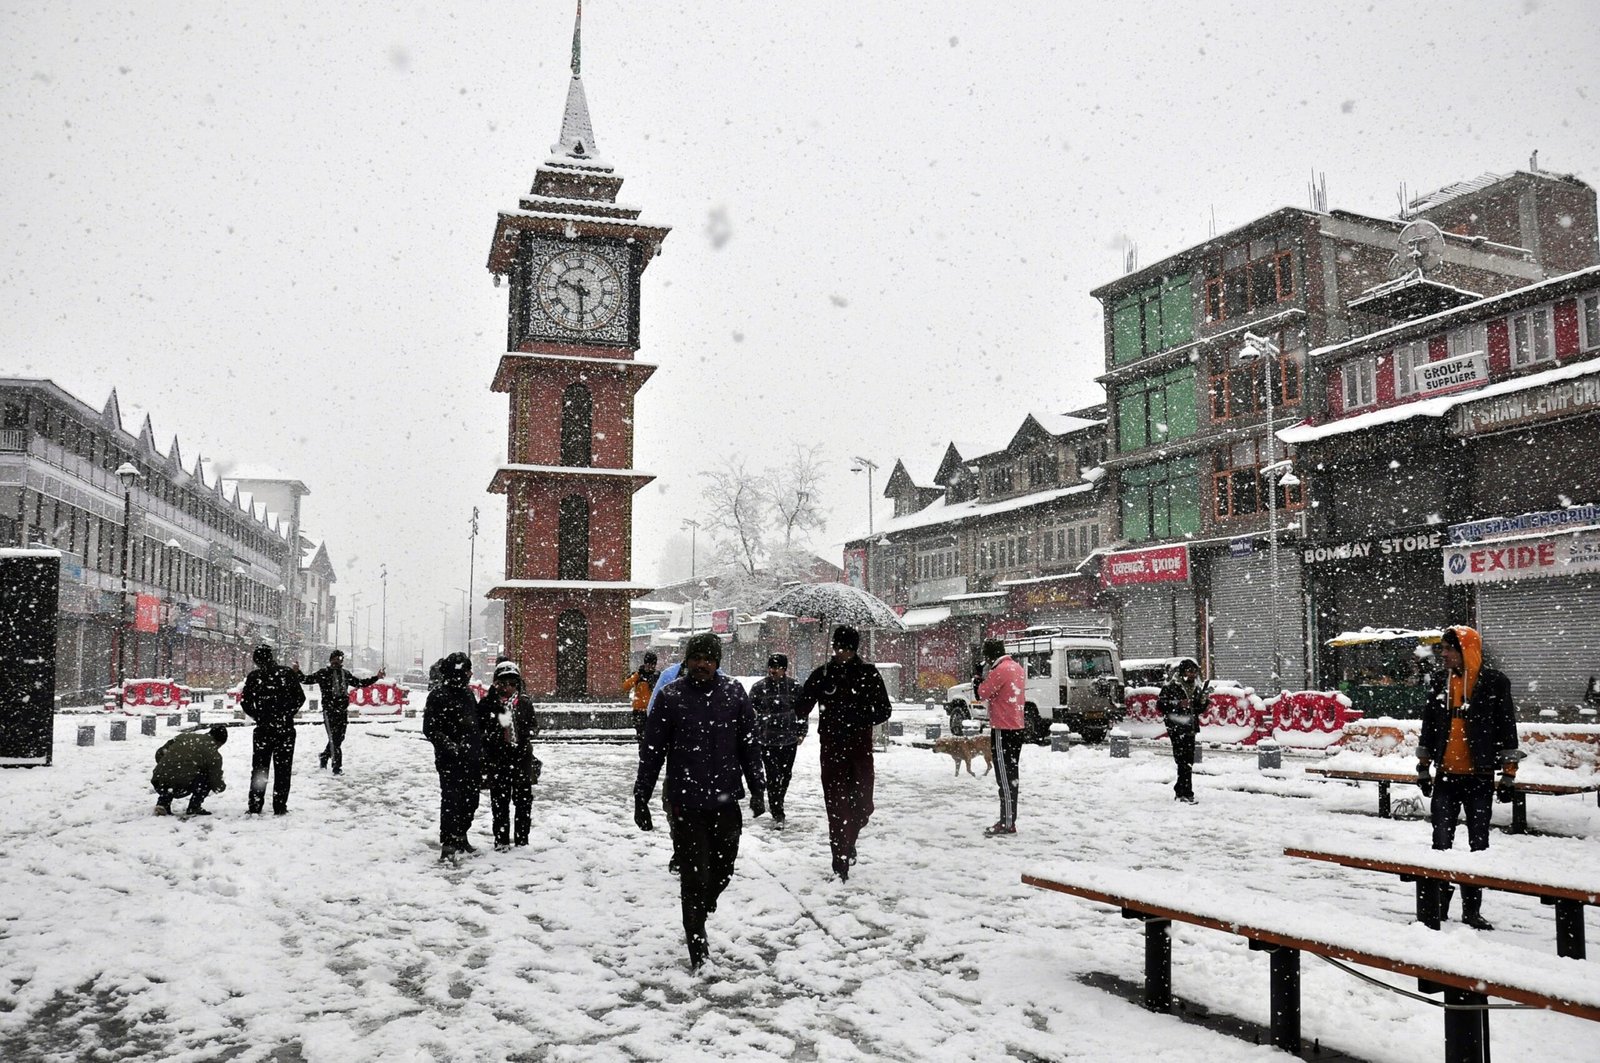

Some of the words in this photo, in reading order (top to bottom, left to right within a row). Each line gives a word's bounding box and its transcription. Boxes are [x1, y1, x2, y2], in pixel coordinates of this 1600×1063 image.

[1424, 361, 1474, 380] GROUP-4
[1426, 370, 1476, 389] SUPPLIERS
[1480, 394, 1532, 424] SHAWL
[1486, 518, 1527, 534] SHAWL
[1304, 542, 1371, 564] BOMBAY
[1381, 534, 1441, 554] STORE
[1470, 542, 1556, 573] EXIDE
[1152, 557, 1182, 571] EXIDE
